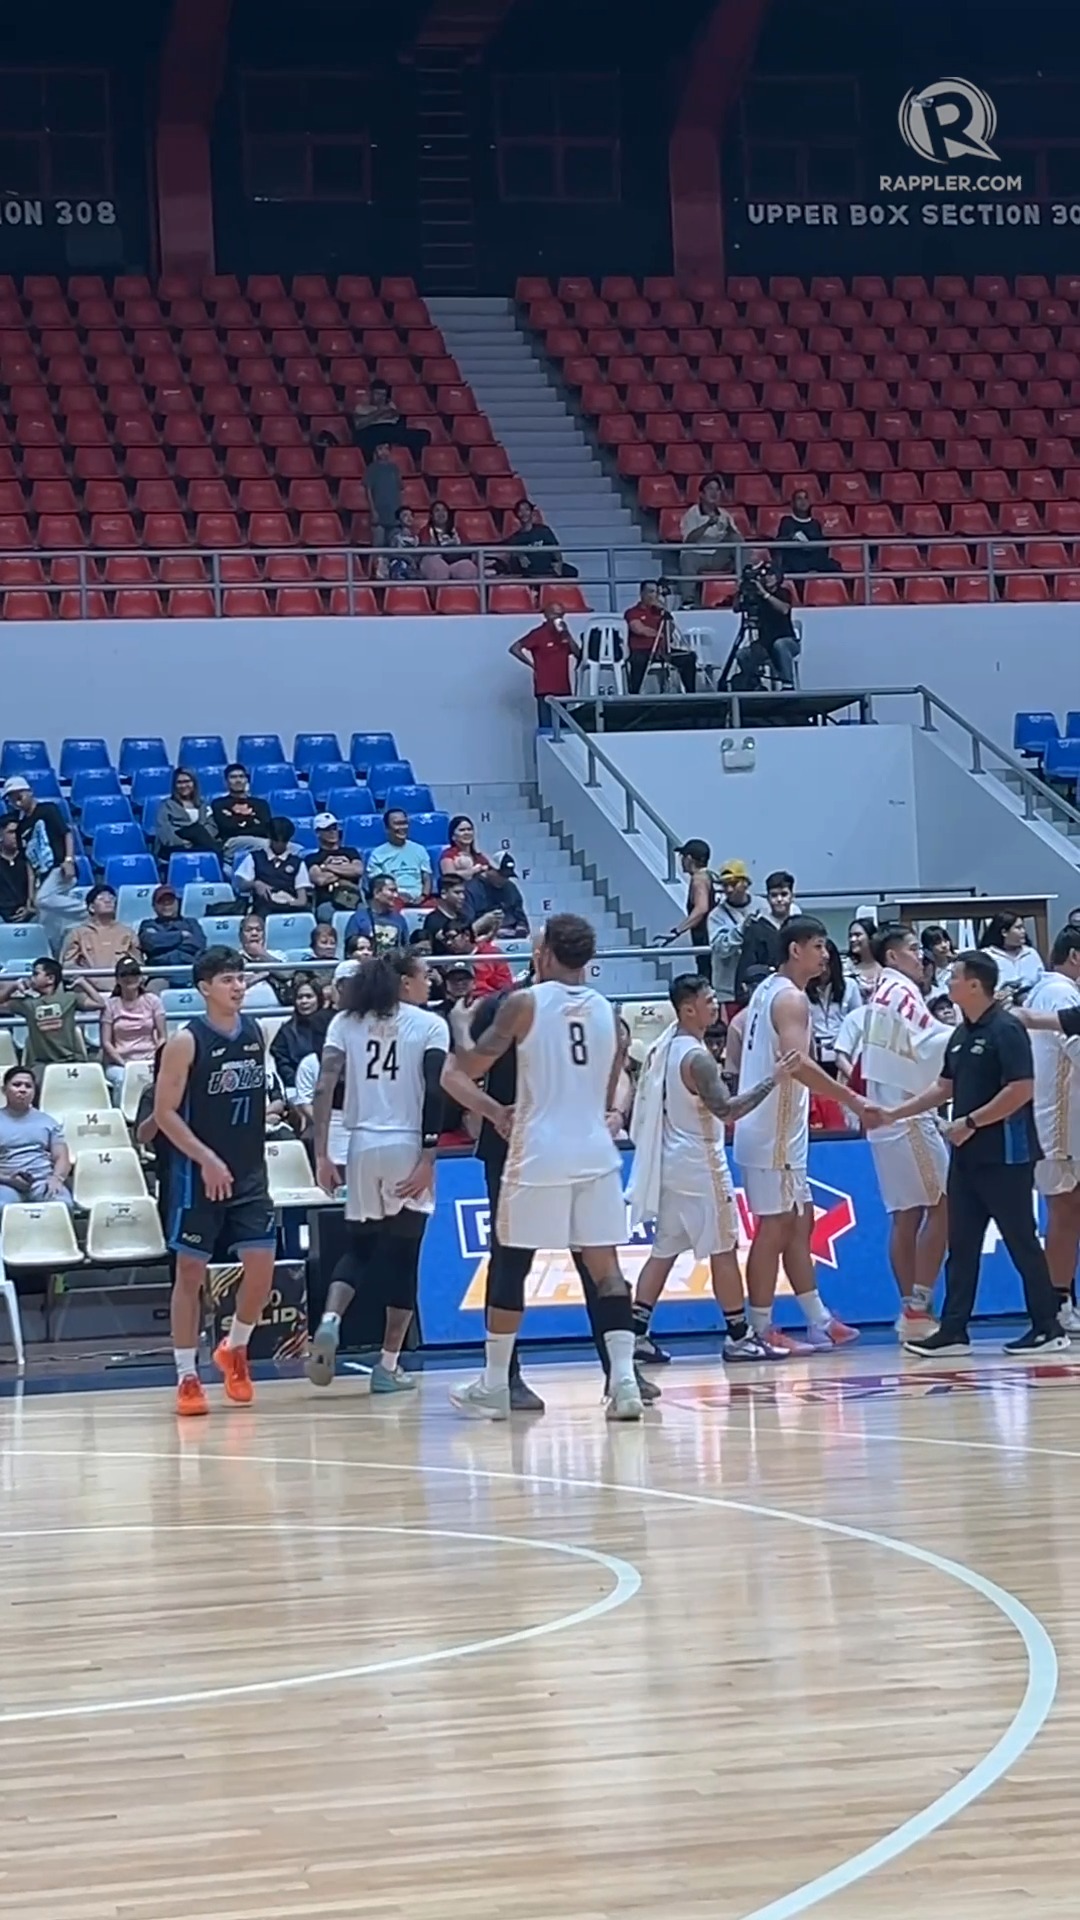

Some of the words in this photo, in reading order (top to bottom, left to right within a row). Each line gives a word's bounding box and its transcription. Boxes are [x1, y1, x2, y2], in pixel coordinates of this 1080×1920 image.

[0, 200, 43, 225] ON
[55, 201, 116, 225] 308
[748, 204, 838, 225] UPPER
[850, 204, 909, 226] BOX
[922, 203, 1040, 226] SECTION
[481, 811, 491, 823] H
[522, 869, 531, 880] F
[543, 900, 552, 911] E
[13, 927, 28, 938] 23
[590, 965, 601, 978] C
[640, 1005, 656, 1017] 22
[569, 1021, 588, 1066] 8
[365, 1039, 400, 1082] 24
[66, 1068, 79, 1079] 14
[230, 1096, 251, 1126] 71
[86, 1113, 99, 1125] 14
[98, 1153, 112, 1165] 14
